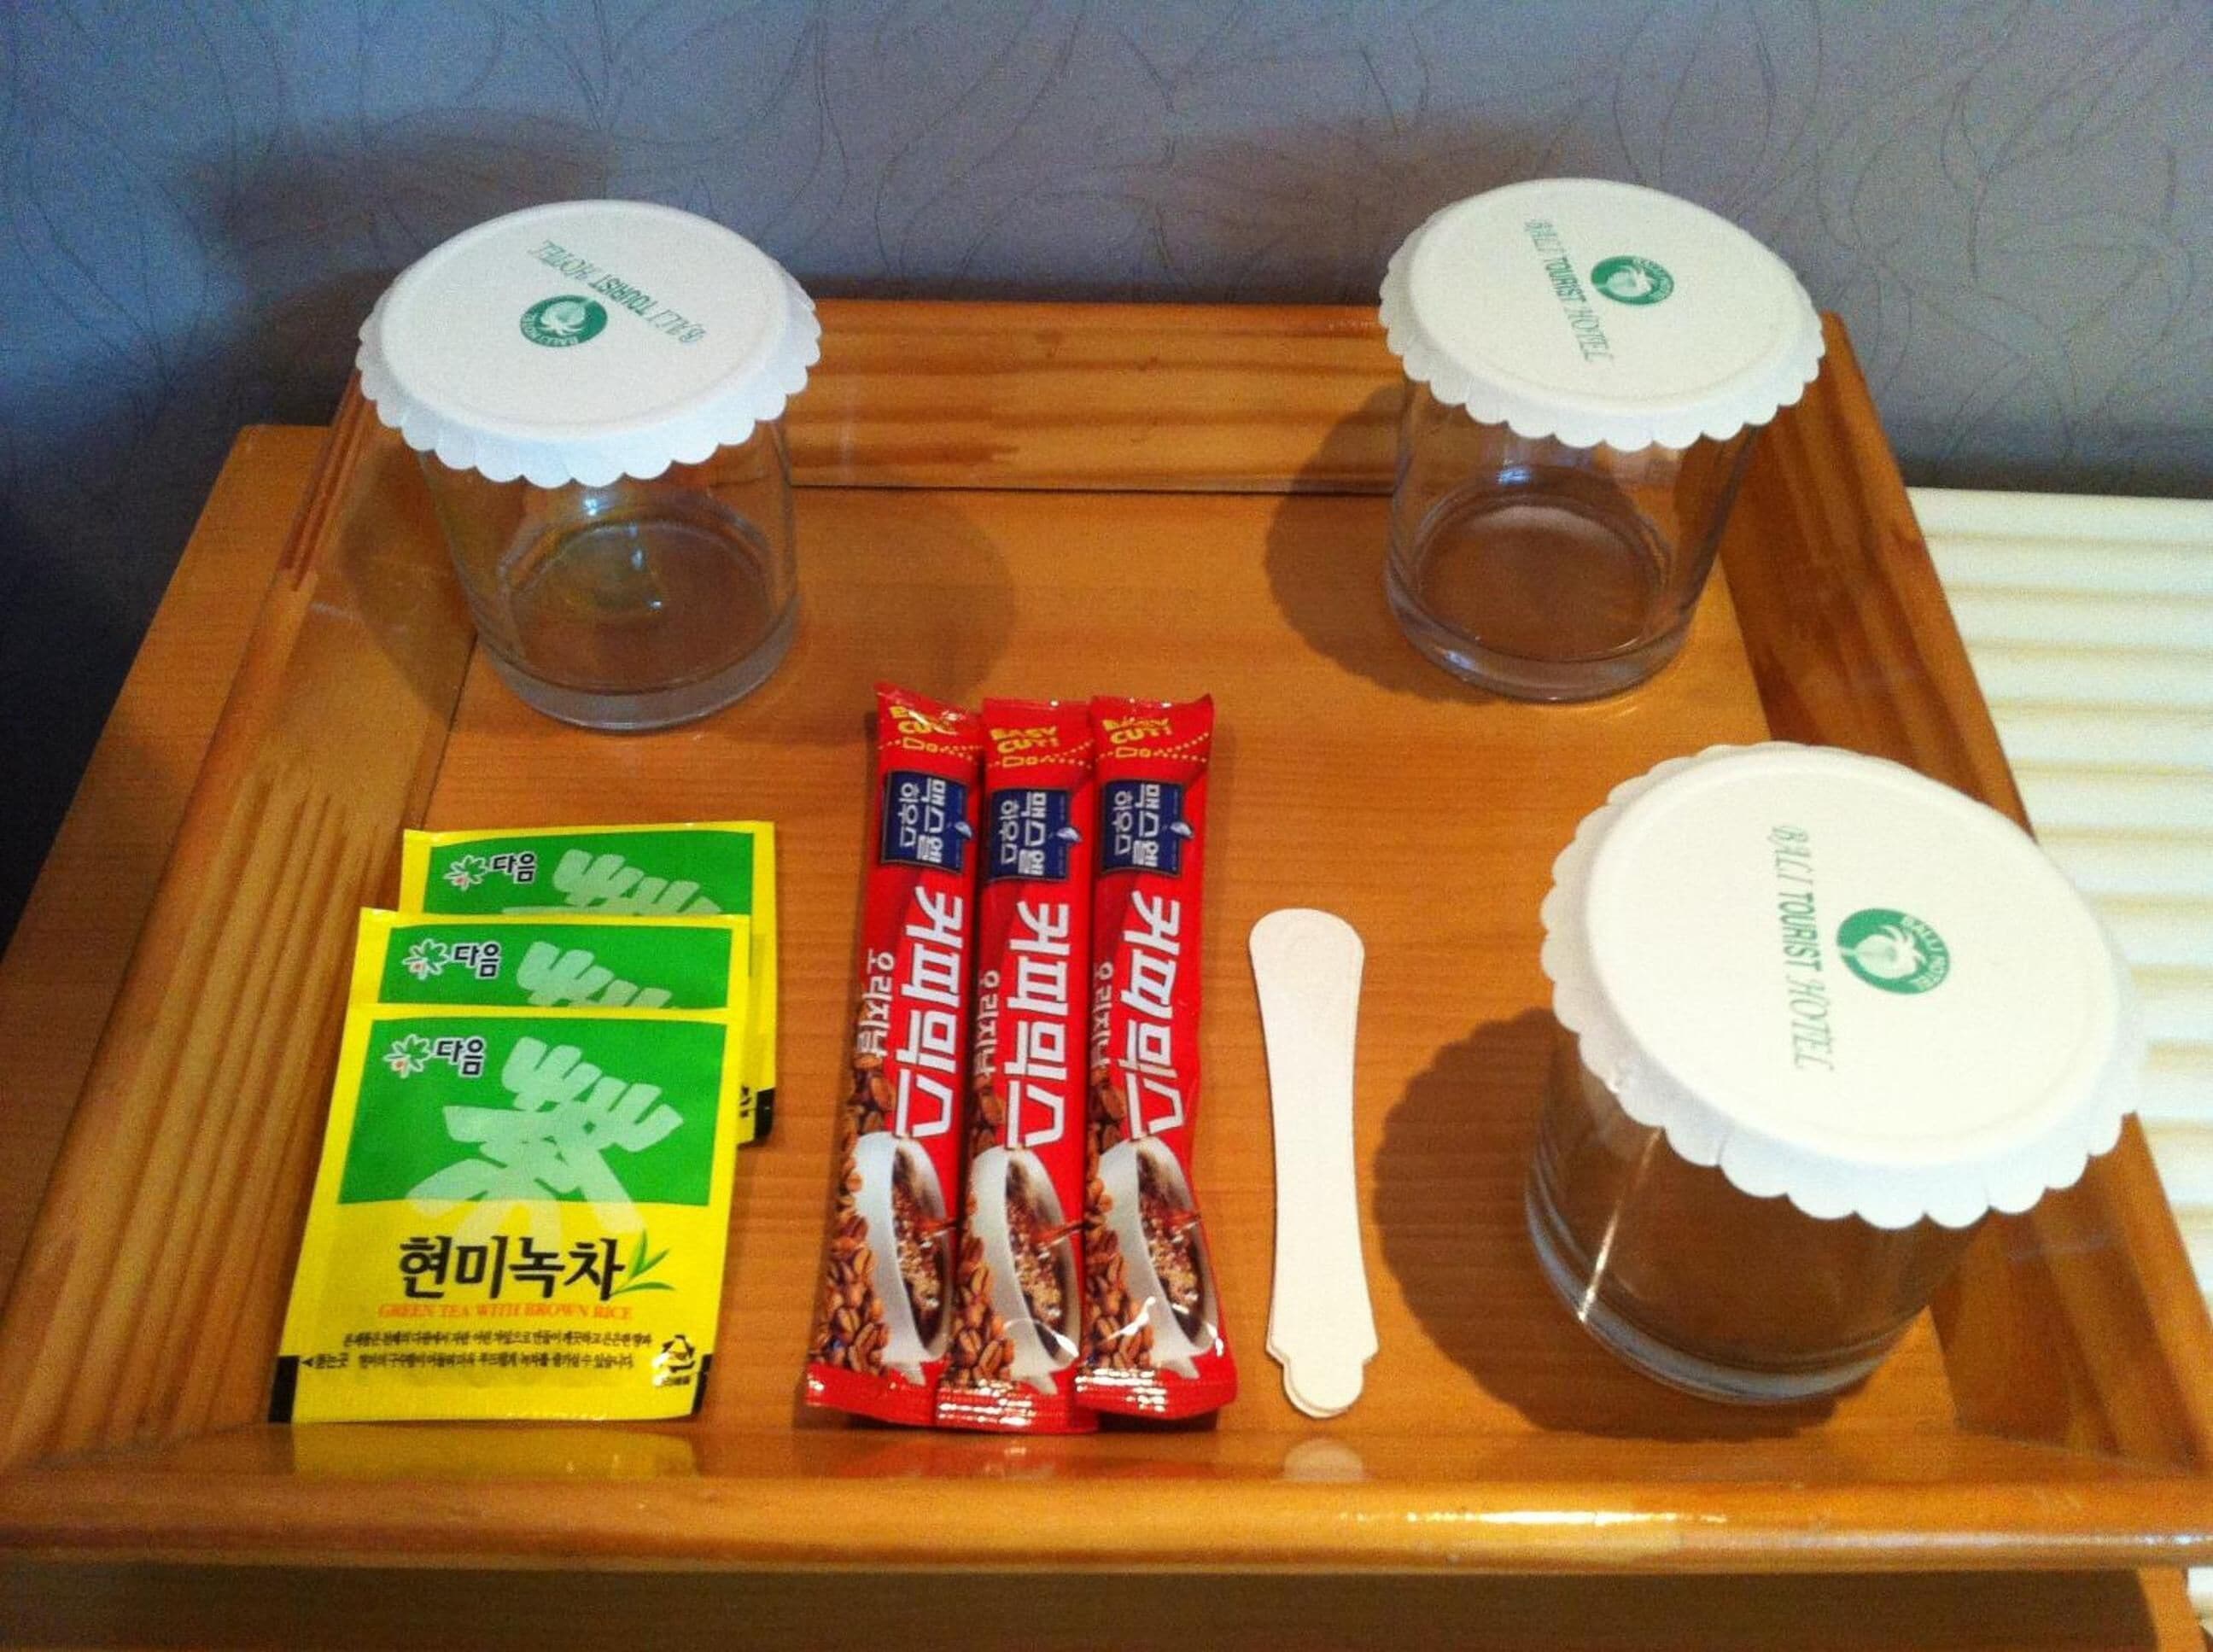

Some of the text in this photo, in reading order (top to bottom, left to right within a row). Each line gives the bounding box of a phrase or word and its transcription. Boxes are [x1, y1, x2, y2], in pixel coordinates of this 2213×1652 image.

[527, 239, 597, 281] HOTEL
[1544, 255, 1587, 303] TOURIST
[587, 273, 656, 317] TOURIST
[1563, 303, 1614, 362] HOTEL
[897, 782, 920, 848] 하우스
[917, 777, 946, 864] 맥스웰
[998, 800, 1019, 865] 하우스
[1018, 791, 1047, 876] 맥스웰
[1112, 791, 1133, 856] 하우스
[1132, 784, 1160, 867] 맥스웰
[490, 852, 535, 883] 다음
[453, 943, 500, 978] 다음
[1767, 825, 1836, 1071] BALI TOURIST HOTEL
[856, 948, 895, 1059] 오리지날
[895, 885, 964, 1139] 커피믹스
[1004, 900, 1071, 1149] 커피믹스
[1117, 890, 1184, 1141] 커피믹스
[435, 1037, 484, 1075] 다음
[399, 1235, 626, 1301] 현미녹차
[378, 1304, 633, 1320] GREEN TEA WITH BROWN RICE
